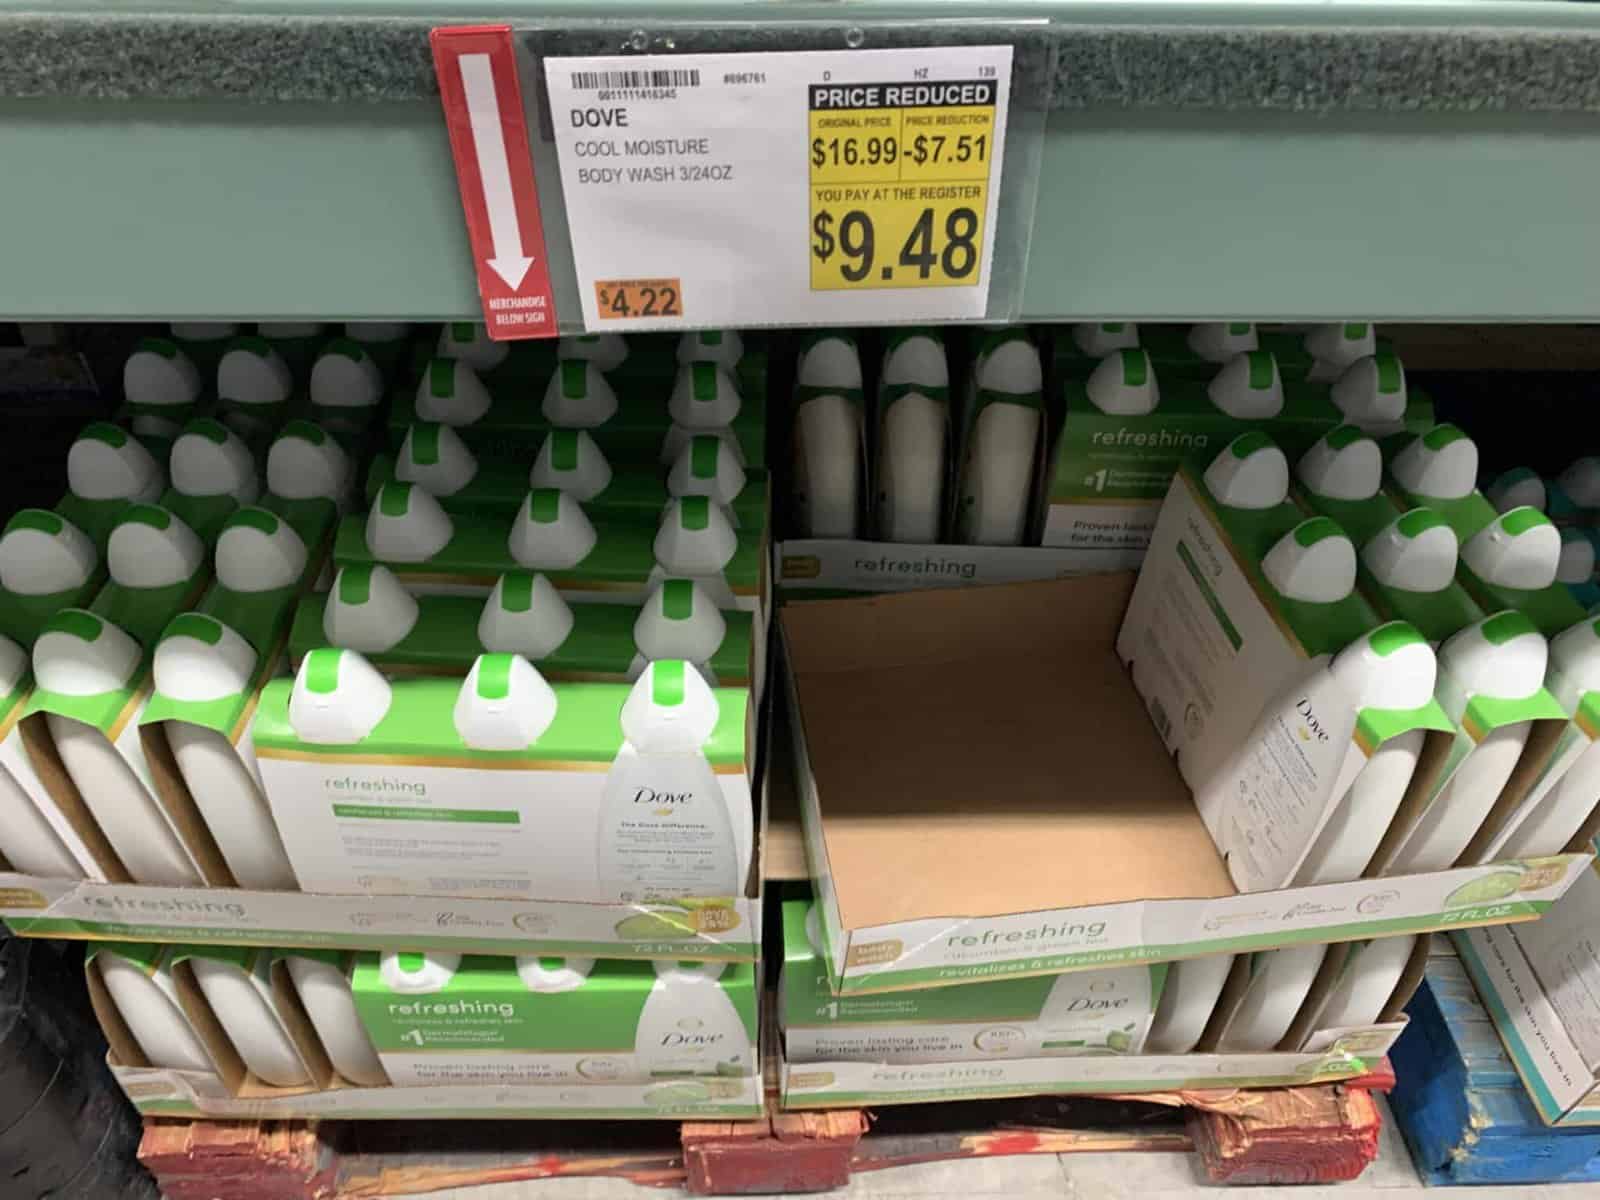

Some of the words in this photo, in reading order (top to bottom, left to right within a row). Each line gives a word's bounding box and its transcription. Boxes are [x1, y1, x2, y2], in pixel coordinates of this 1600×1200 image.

[823, 71, 831, 81] D
[914, 68, 929, 79] HZ
[815, 88, 880, 107] PRICE
[885, 85, 990, 105] REDUCED
[570, 108, 628, 128] DOVE
[818, 118, 861, 129] ORIGINAL
[864, 117, 891, 127] PRICE
[906, 116, 932, 126] PRICE
[936, 114, 989, 125] REDUCTION
[574, 141, 620, 157] COOL
[624, 138, 709, 156] MOISTURE
[812, 136, 897, 168] $16.99
[904, 133, 986, 167] -$7.51
[578, 168, 623, 184] BODY
[627, 167, 675, 182] WASH
[680, 164, 733, 181] 3/24OZ
[816, 190, 841, 203] YOU
[845, 189, 869, 201] PAY
[873, 188, 888, 200] AT
[893, 188, 917, 200] THE
[920, 185, 981, 199] REGISTER
[813, 206, 978, 282] $9.48
[489, 296, 545, 310] MERCHANDISE
[599, 287, 677, 317] $4.22
[854, 555, 977, 579] refreshing
[1295, 696, 1329, 744] Dove
[325, 776, 427, 796] refreshing
[632, 786, 693, 804] Dove
[84, 895, 248, 918] refreshing
[947, 919, 1107, 948] refreshing
[388, 1000, 514, 1017] refreshing
[1066, 995, 1129, 1012] Dove
[660, 1030, 724, 1046] Dove
